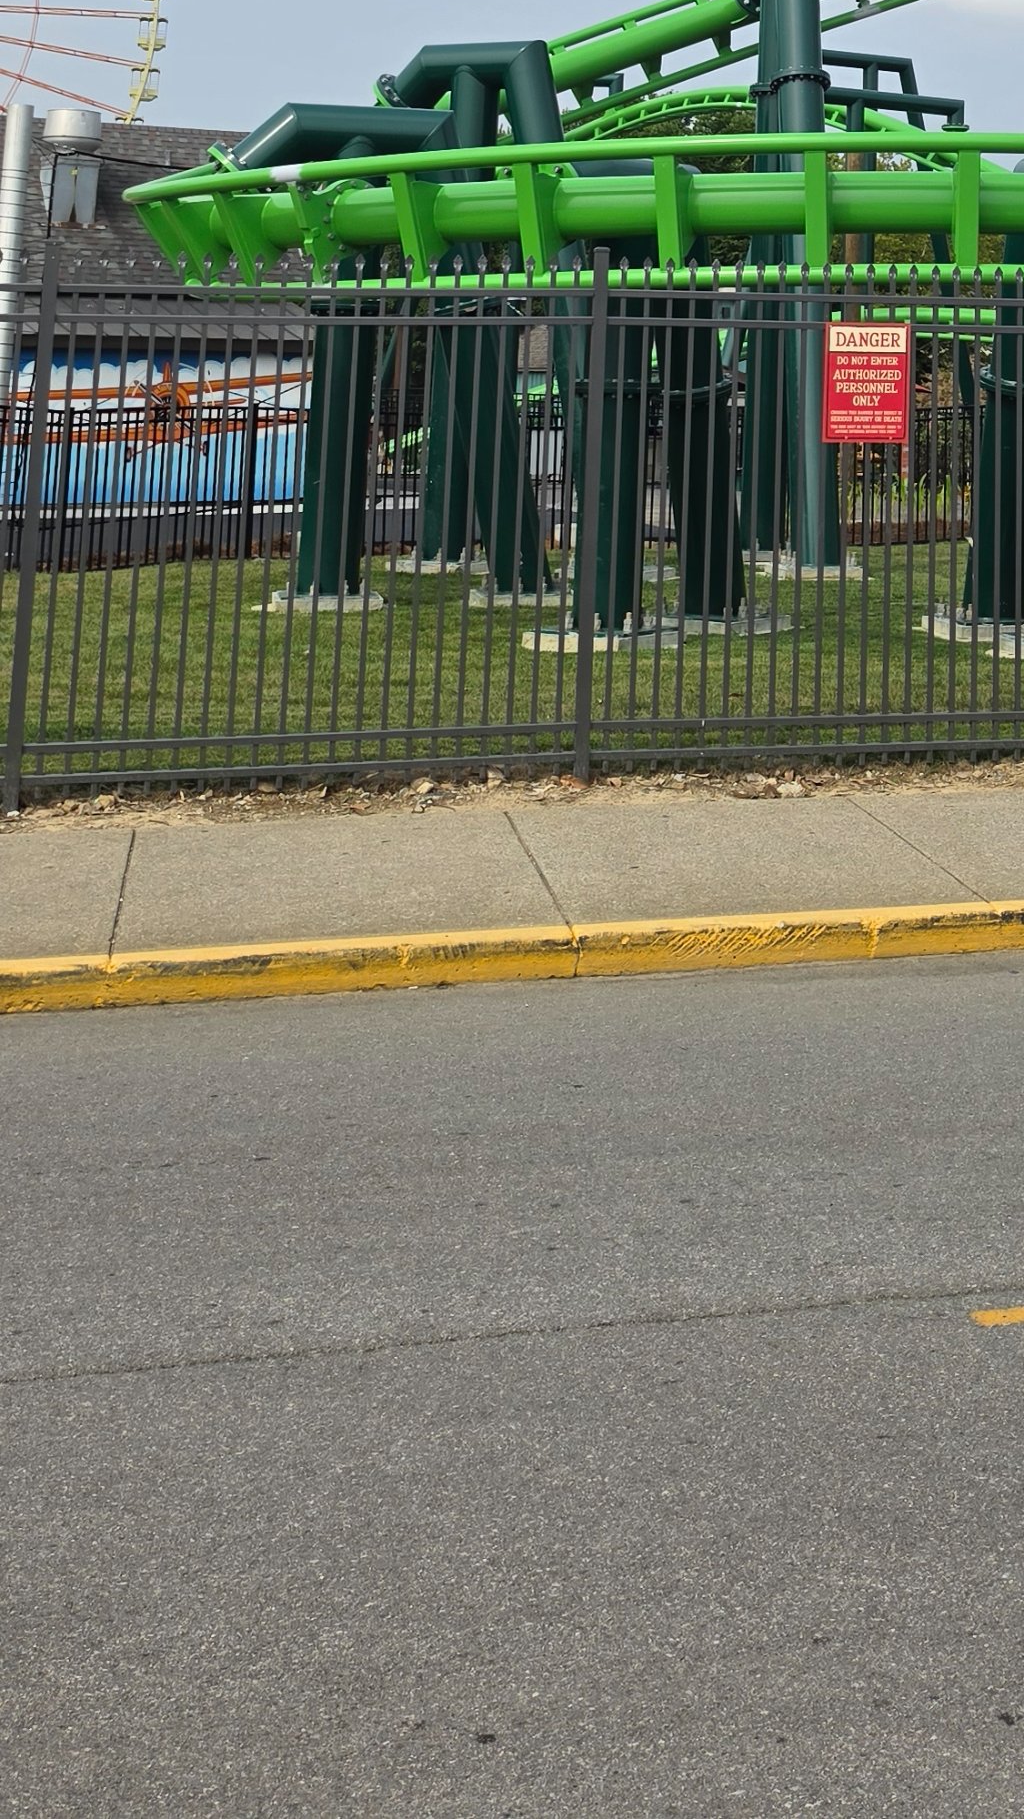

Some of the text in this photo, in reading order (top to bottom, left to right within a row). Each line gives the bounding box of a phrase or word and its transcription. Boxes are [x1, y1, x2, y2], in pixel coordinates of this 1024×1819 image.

[835, 331, 901, 347] DANGER
[836, 356, 899, 366] DO NOT ENTER
[832, 369, 902, 381] AUTHORIZED
[835, 382, 899, 394] PERSONNEL
[852, 395, 881, 407] ONLY
